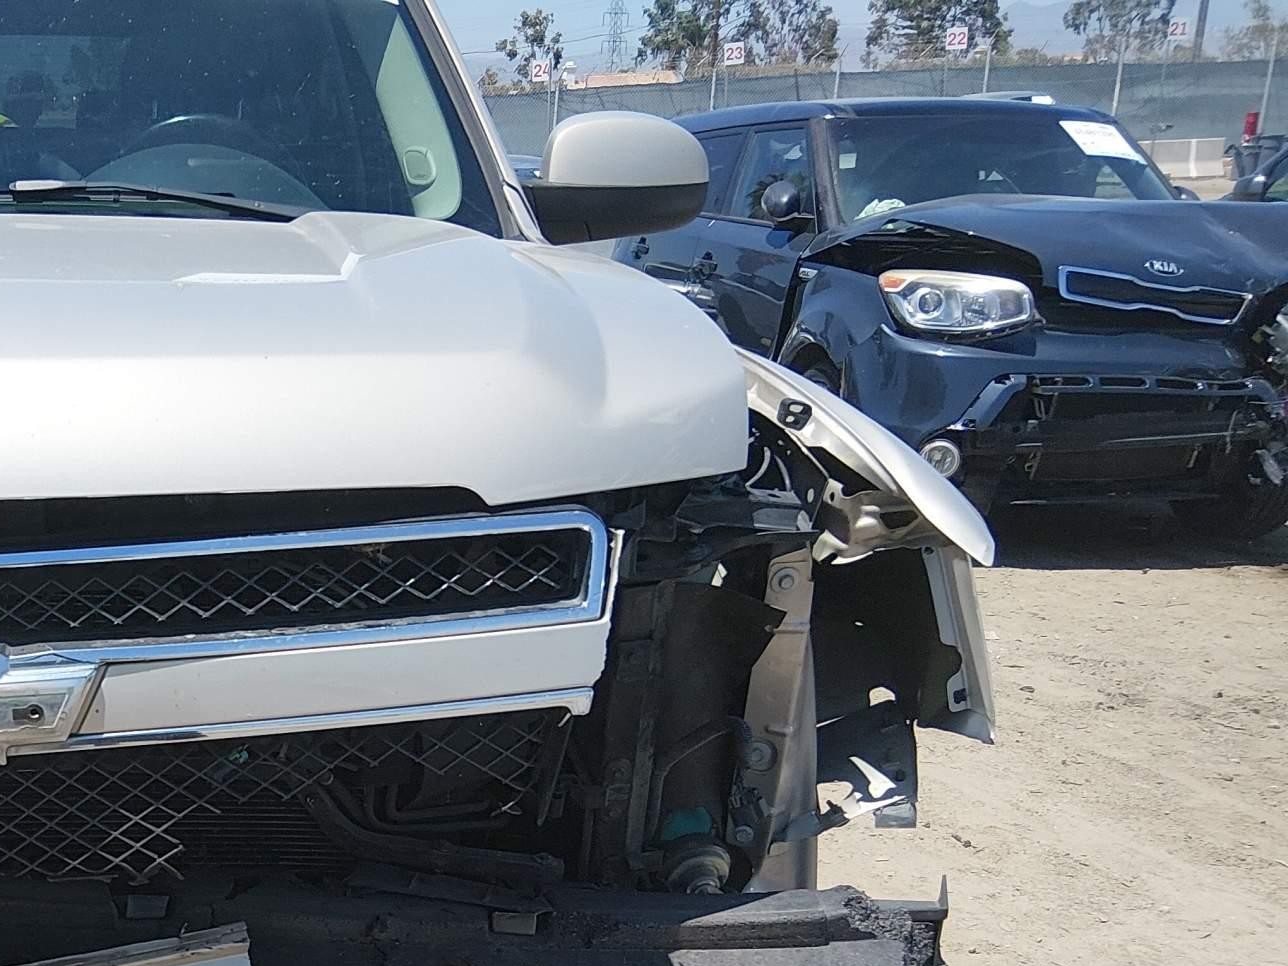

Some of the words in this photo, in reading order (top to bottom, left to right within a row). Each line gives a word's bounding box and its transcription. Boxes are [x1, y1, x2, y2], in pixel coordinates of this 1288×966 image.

[1168, 21, 1187, 37] 21
[947, 31, 967, 46] 22
[726, 46, 744, 61] 23
[533, 63, 550, 78] 24
[1150, 259, 1179, 274] KIA
